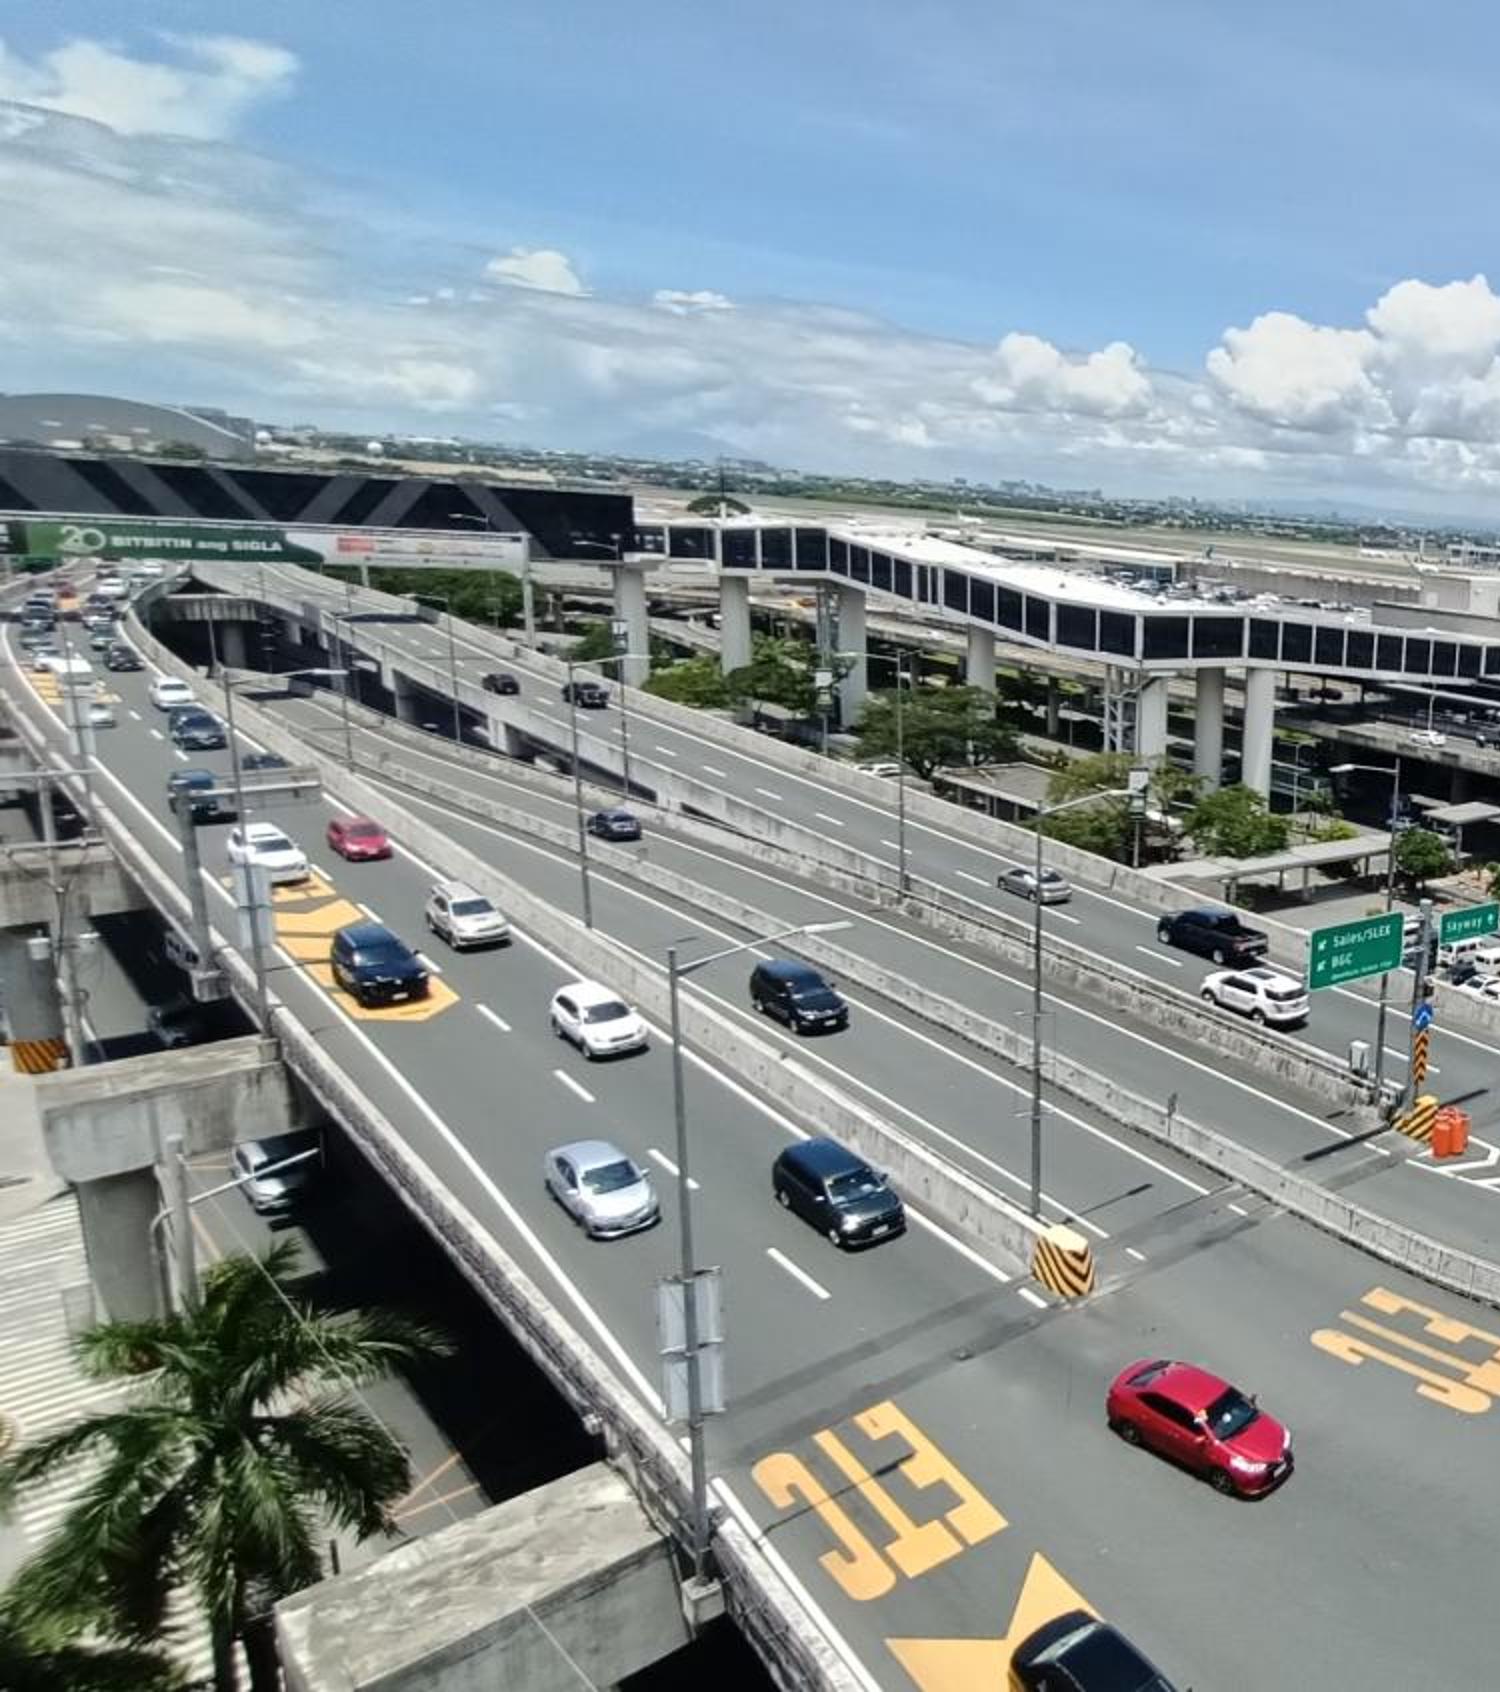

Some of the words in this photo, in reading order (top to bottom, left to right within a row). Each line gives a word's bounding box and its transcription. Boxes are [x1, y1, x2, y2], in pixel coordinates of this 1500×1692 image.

[59, 525, 107, 554] 20
[231, 541, 283, 552] SIGLA
[1332, 924, 1392, 949] Sales/SLEX
[1445, 915, 1484, 934] Skyway
[751, 1400, 1009, 1602] ETC
